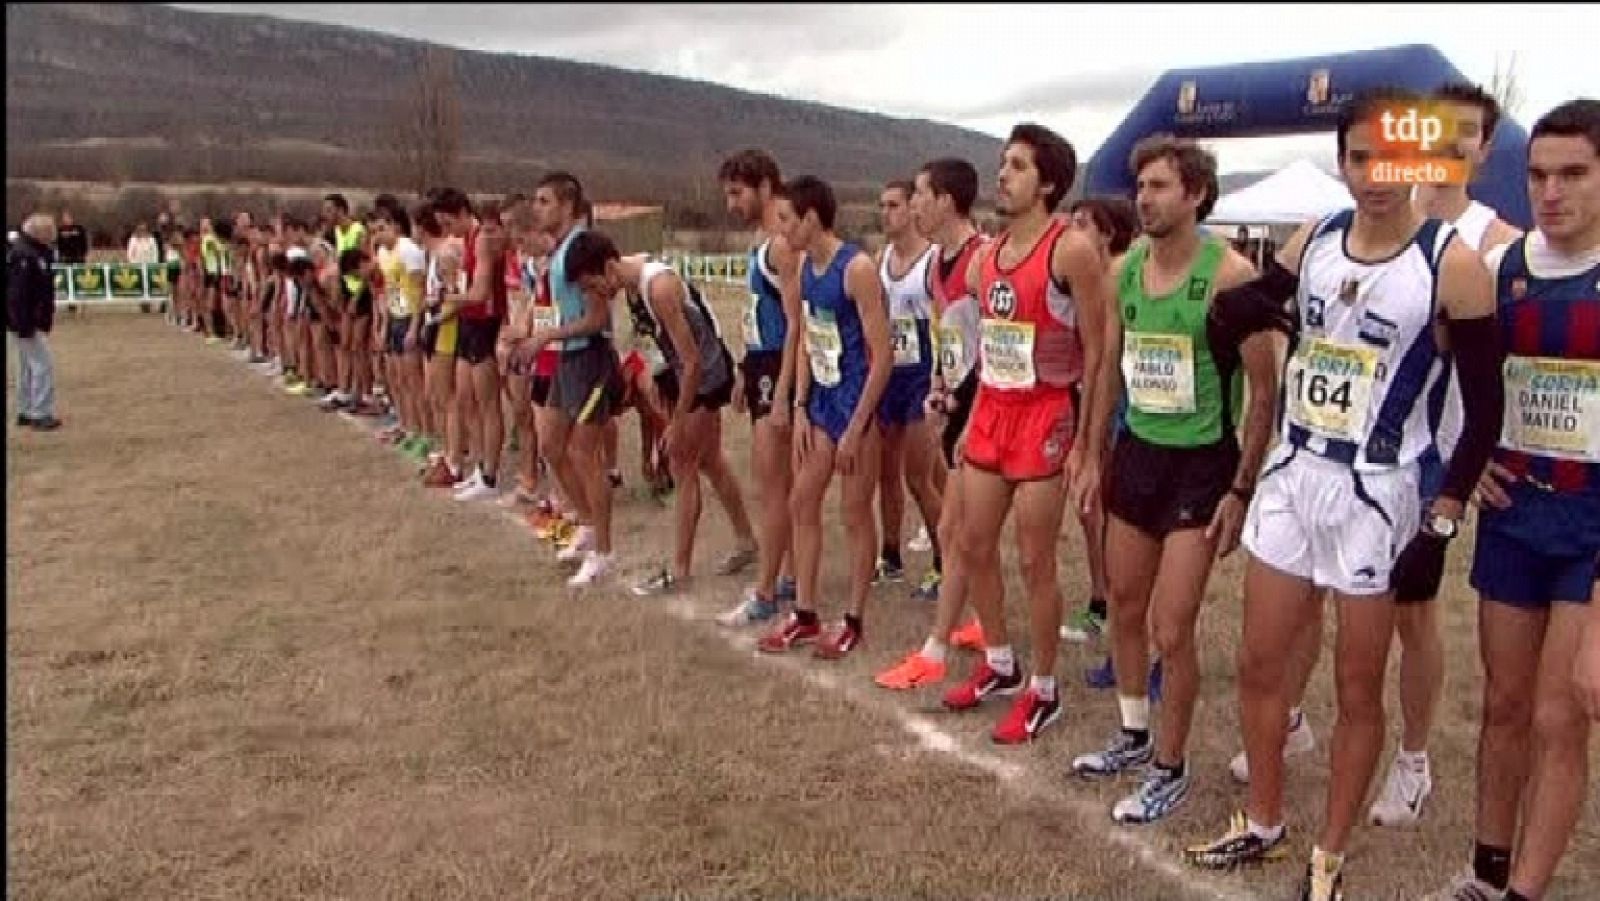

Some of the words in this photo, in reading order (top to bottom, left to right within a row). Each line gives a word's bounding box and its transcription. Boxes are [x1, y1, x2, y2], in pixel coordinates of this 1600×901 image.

[1132, 361, 1174, 376] PABLO
[1130, 376, 1178, 392] ALONSO
[1294, 367, 1353, 414] 164
[1519, 389, 1584, 414] DANIEL
[1521, 411, 1577, 433] MATEO
